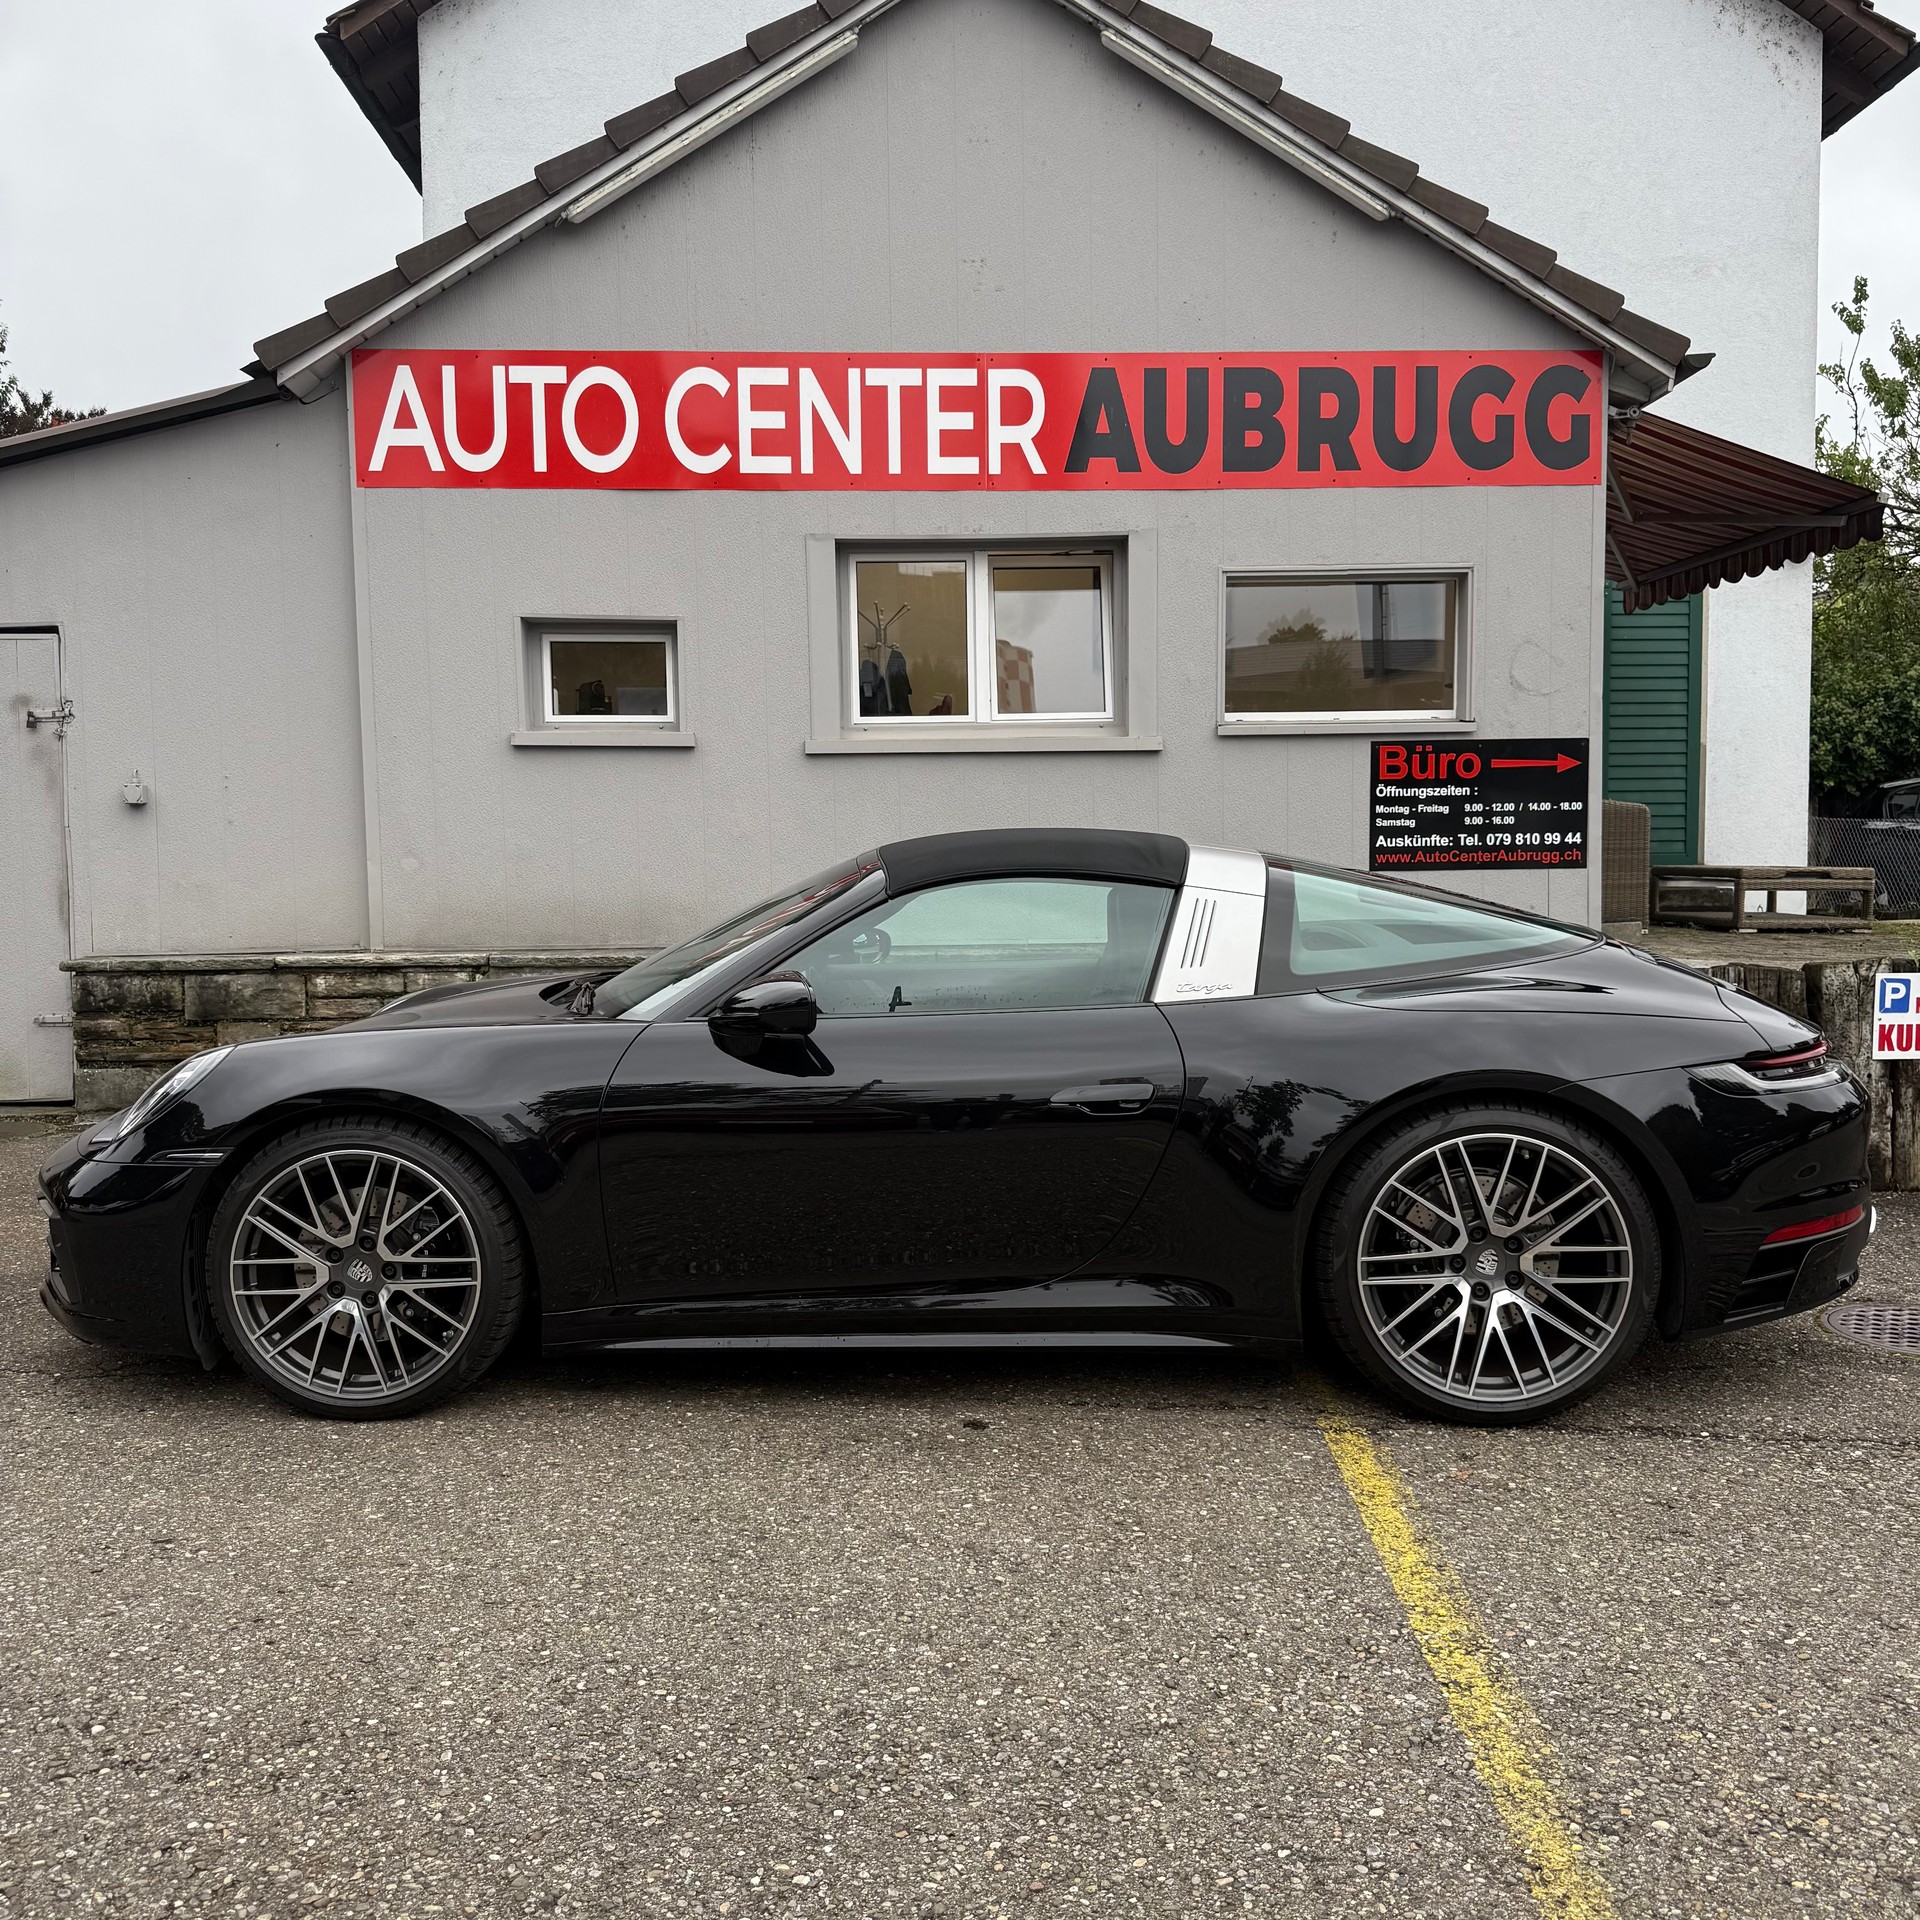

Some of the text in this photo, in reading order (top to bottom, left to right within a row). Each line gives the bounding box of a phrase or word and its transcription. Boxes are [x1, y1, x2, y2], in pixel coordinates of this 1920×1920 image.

[367, 364, 1593, 475] AUTO CENTER AUBRUGG
[1379, 745, 1481, 780] Büro
[1376, 784, 1470, 799] Öffnungszeiten
[1375, 804, 1410, 815] Montag
[1417, 803, 1450, 814] Freitag
[1464, 803, 1483, 812] 9.00
[1491, 802, 1515, 812] 12.00
[1527, 802, 1552, 811] 14.00
[1559, 801, 1583, 811] 18.00
[1375, 818, 1416, 828] Samstag
[1464, 816, 1483, 825] 9.00
[1491, 816, 1515, 825] 16.00
[1375, 831, 1582, 848] Auskünfte: Tel. 079 810 99 44
[1375, 848, 1582, 864] www.AutoCenterAubrugg.ch
[1176, 982, 1233, 995] Targa
[1885, 983, 1906, 1009] P
[1878, 1023, 1920, 1052] KU
